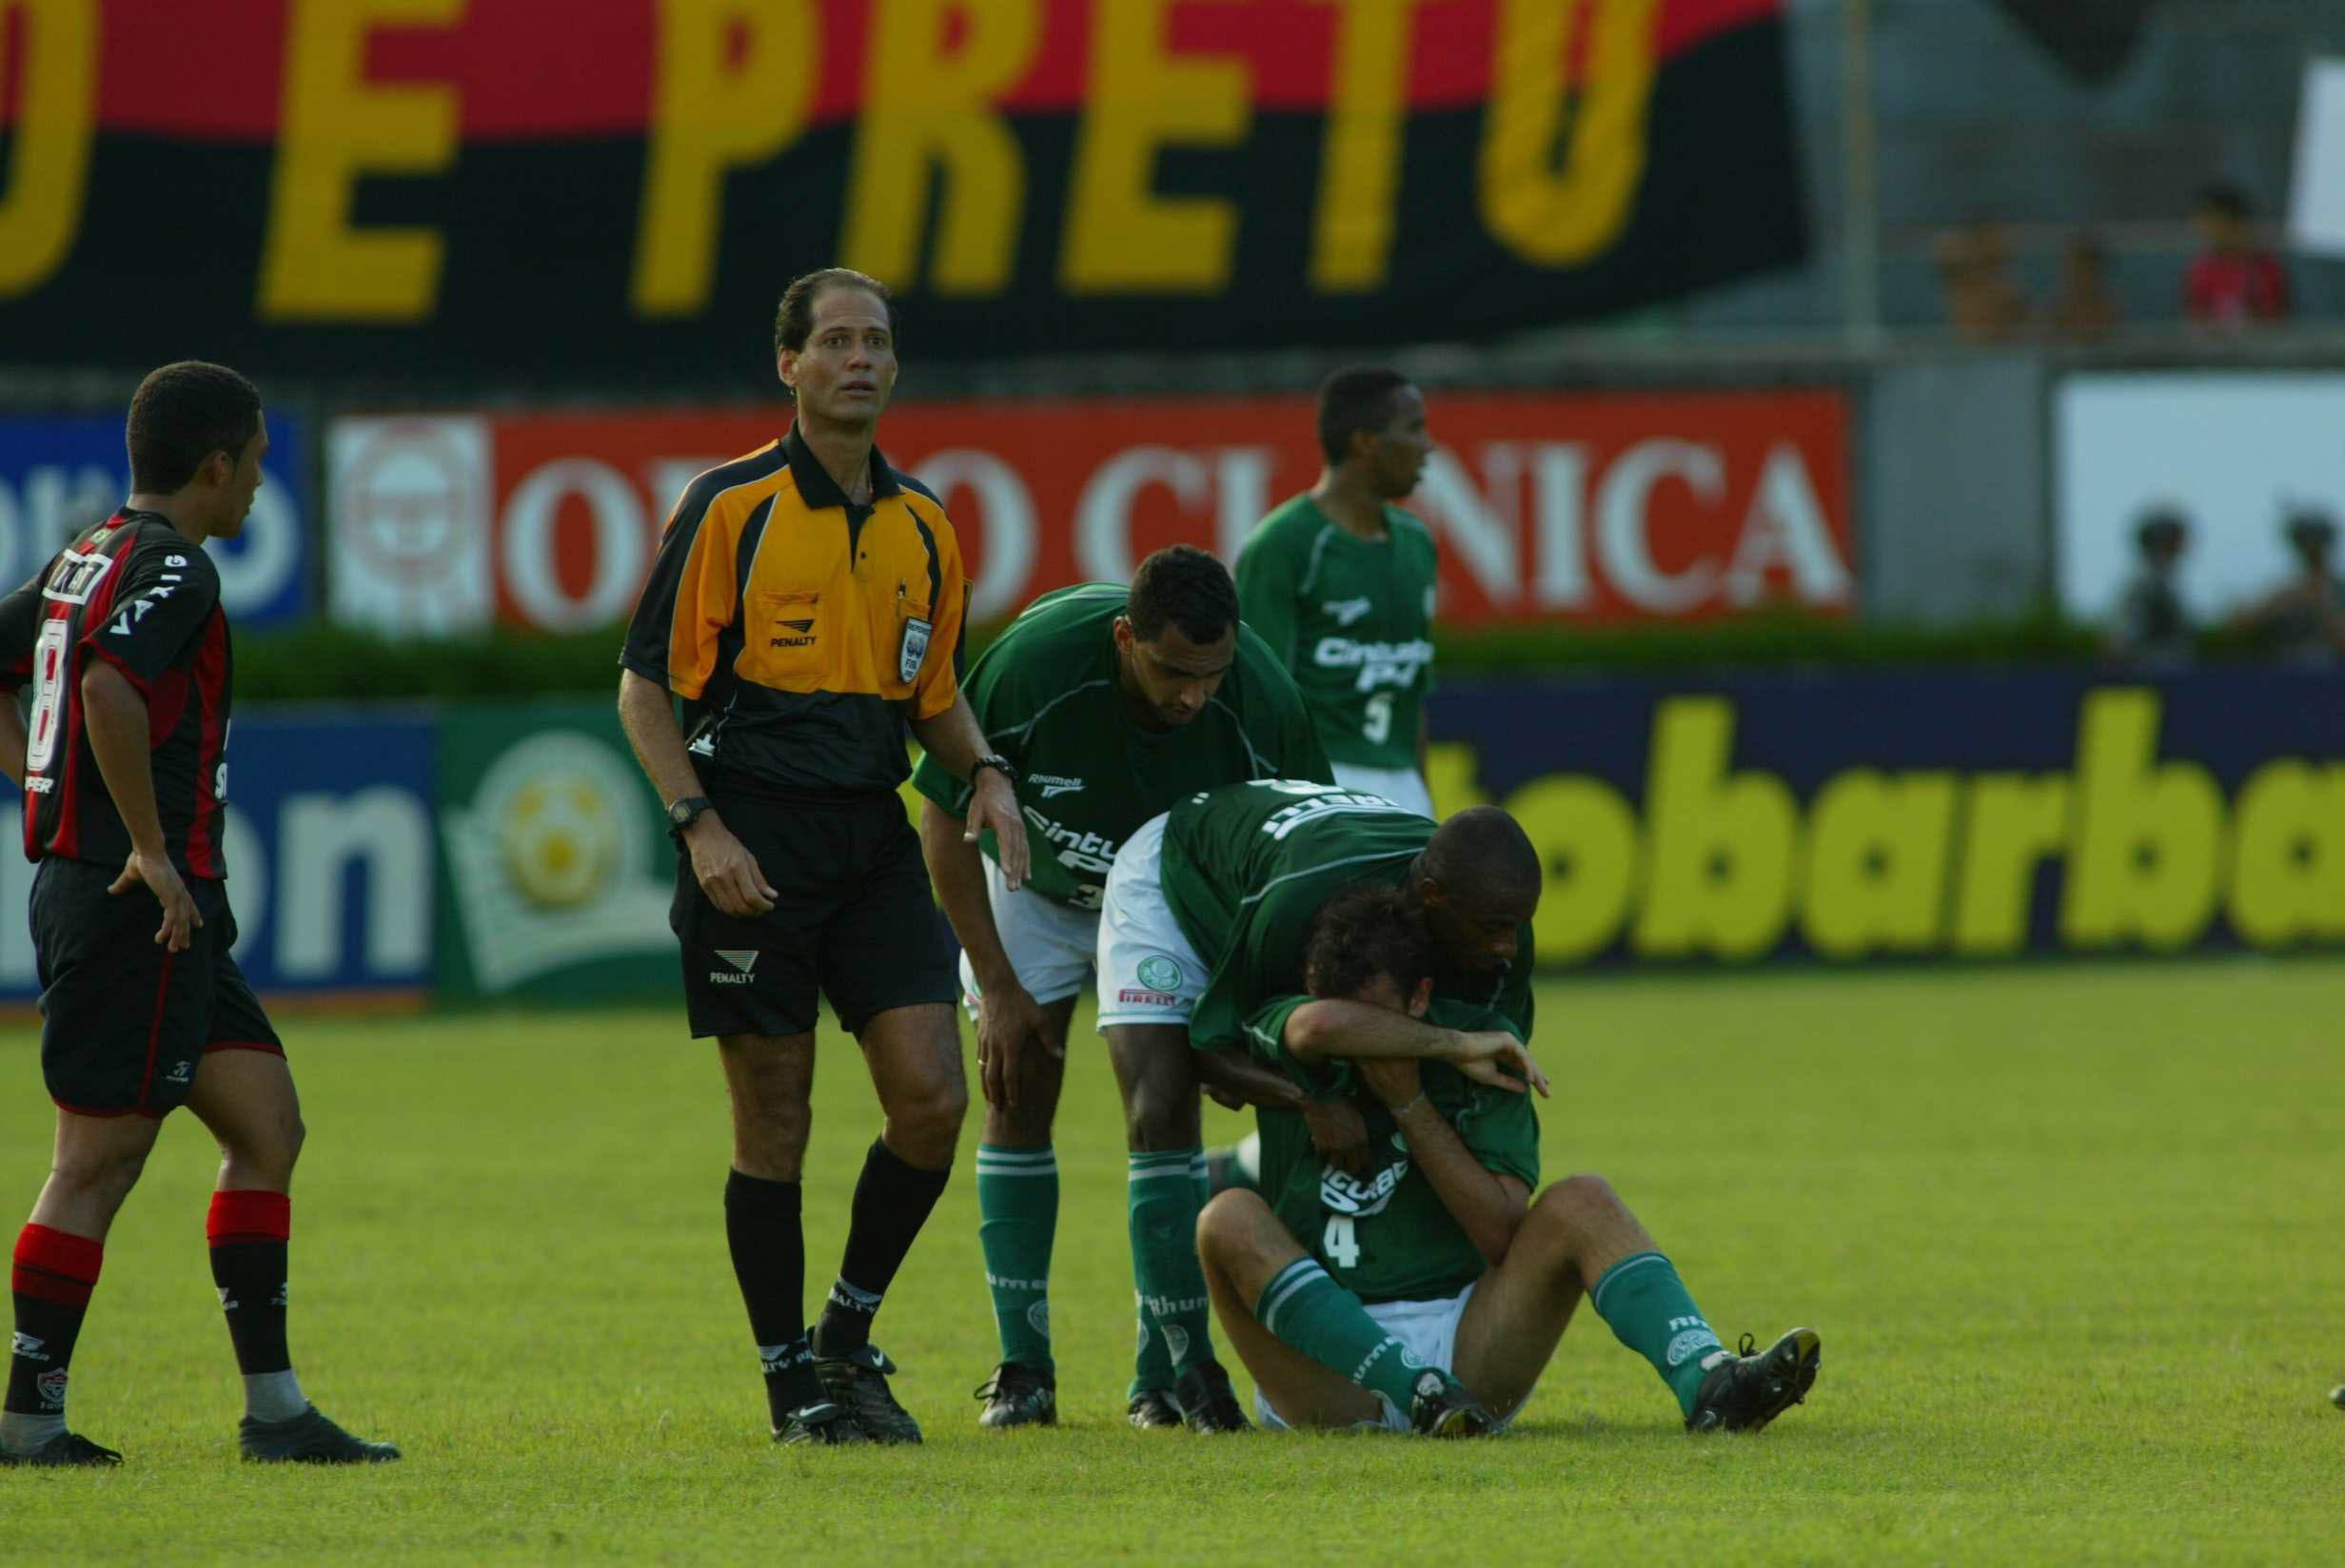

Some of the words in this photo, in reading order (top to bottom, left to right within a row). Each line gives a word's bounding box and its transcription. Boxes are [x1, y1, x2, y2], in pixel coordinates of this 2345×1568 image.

[255, 0, 468, 324] E
[769, 636, 817, 648] PENALTY
[27, 618, 69, 772] 8
[710, 971, 756, 984] PENALTY
[1322, 1215, 1361, 1268] 4
